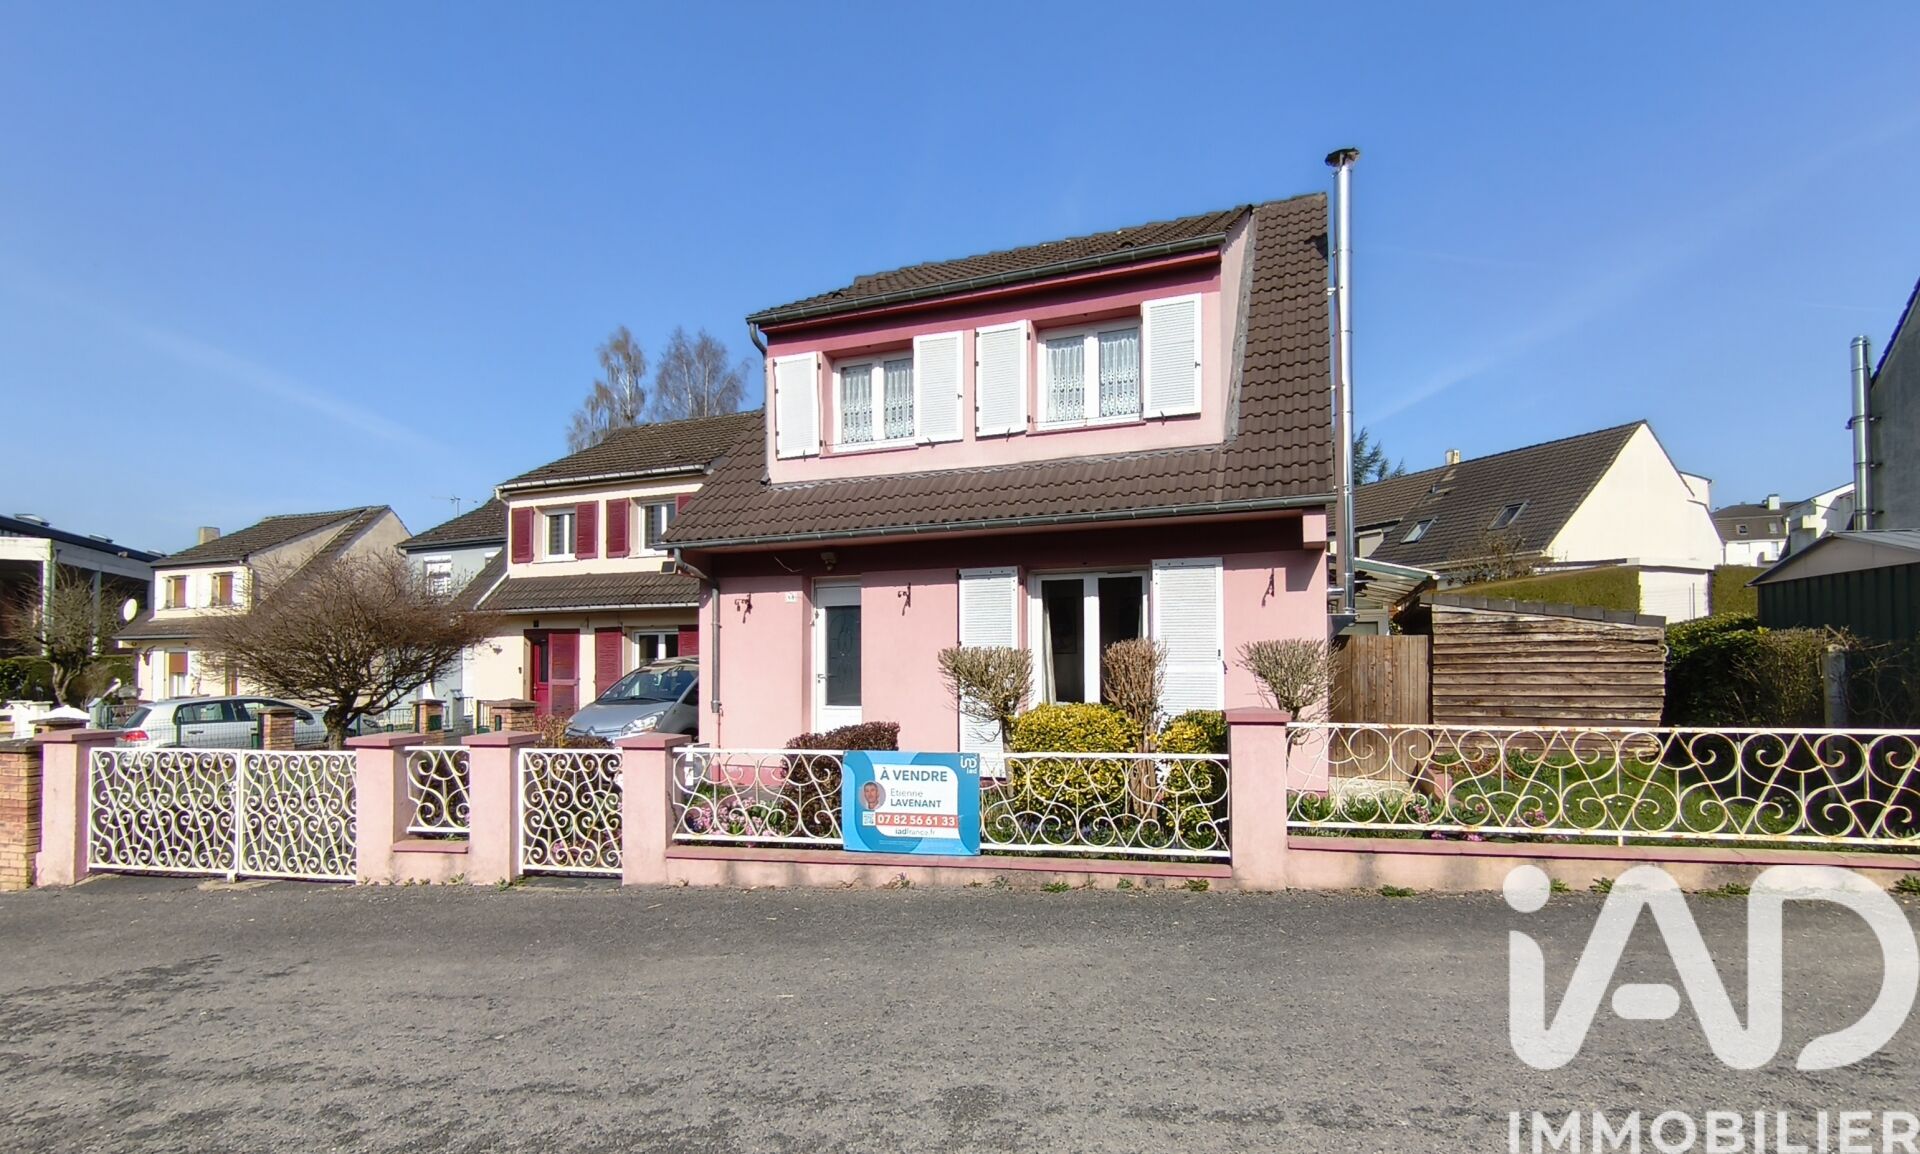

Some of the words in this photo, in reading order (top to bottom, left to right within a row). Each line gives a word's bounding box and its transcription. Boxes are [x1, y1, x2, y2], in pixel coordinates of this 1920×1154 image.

[880, 766, 890, 781] À
[893, 769, 948, 782] VENDRE
[890, 798, 942, 808] LAVENANT
[877, 814, 891, 824] 07
[893, 814, 908, 825] 82
[909, 815, 924, 825] 56
[925, 815, 939, 826] 61
[941, 816, 956, 827] 33
